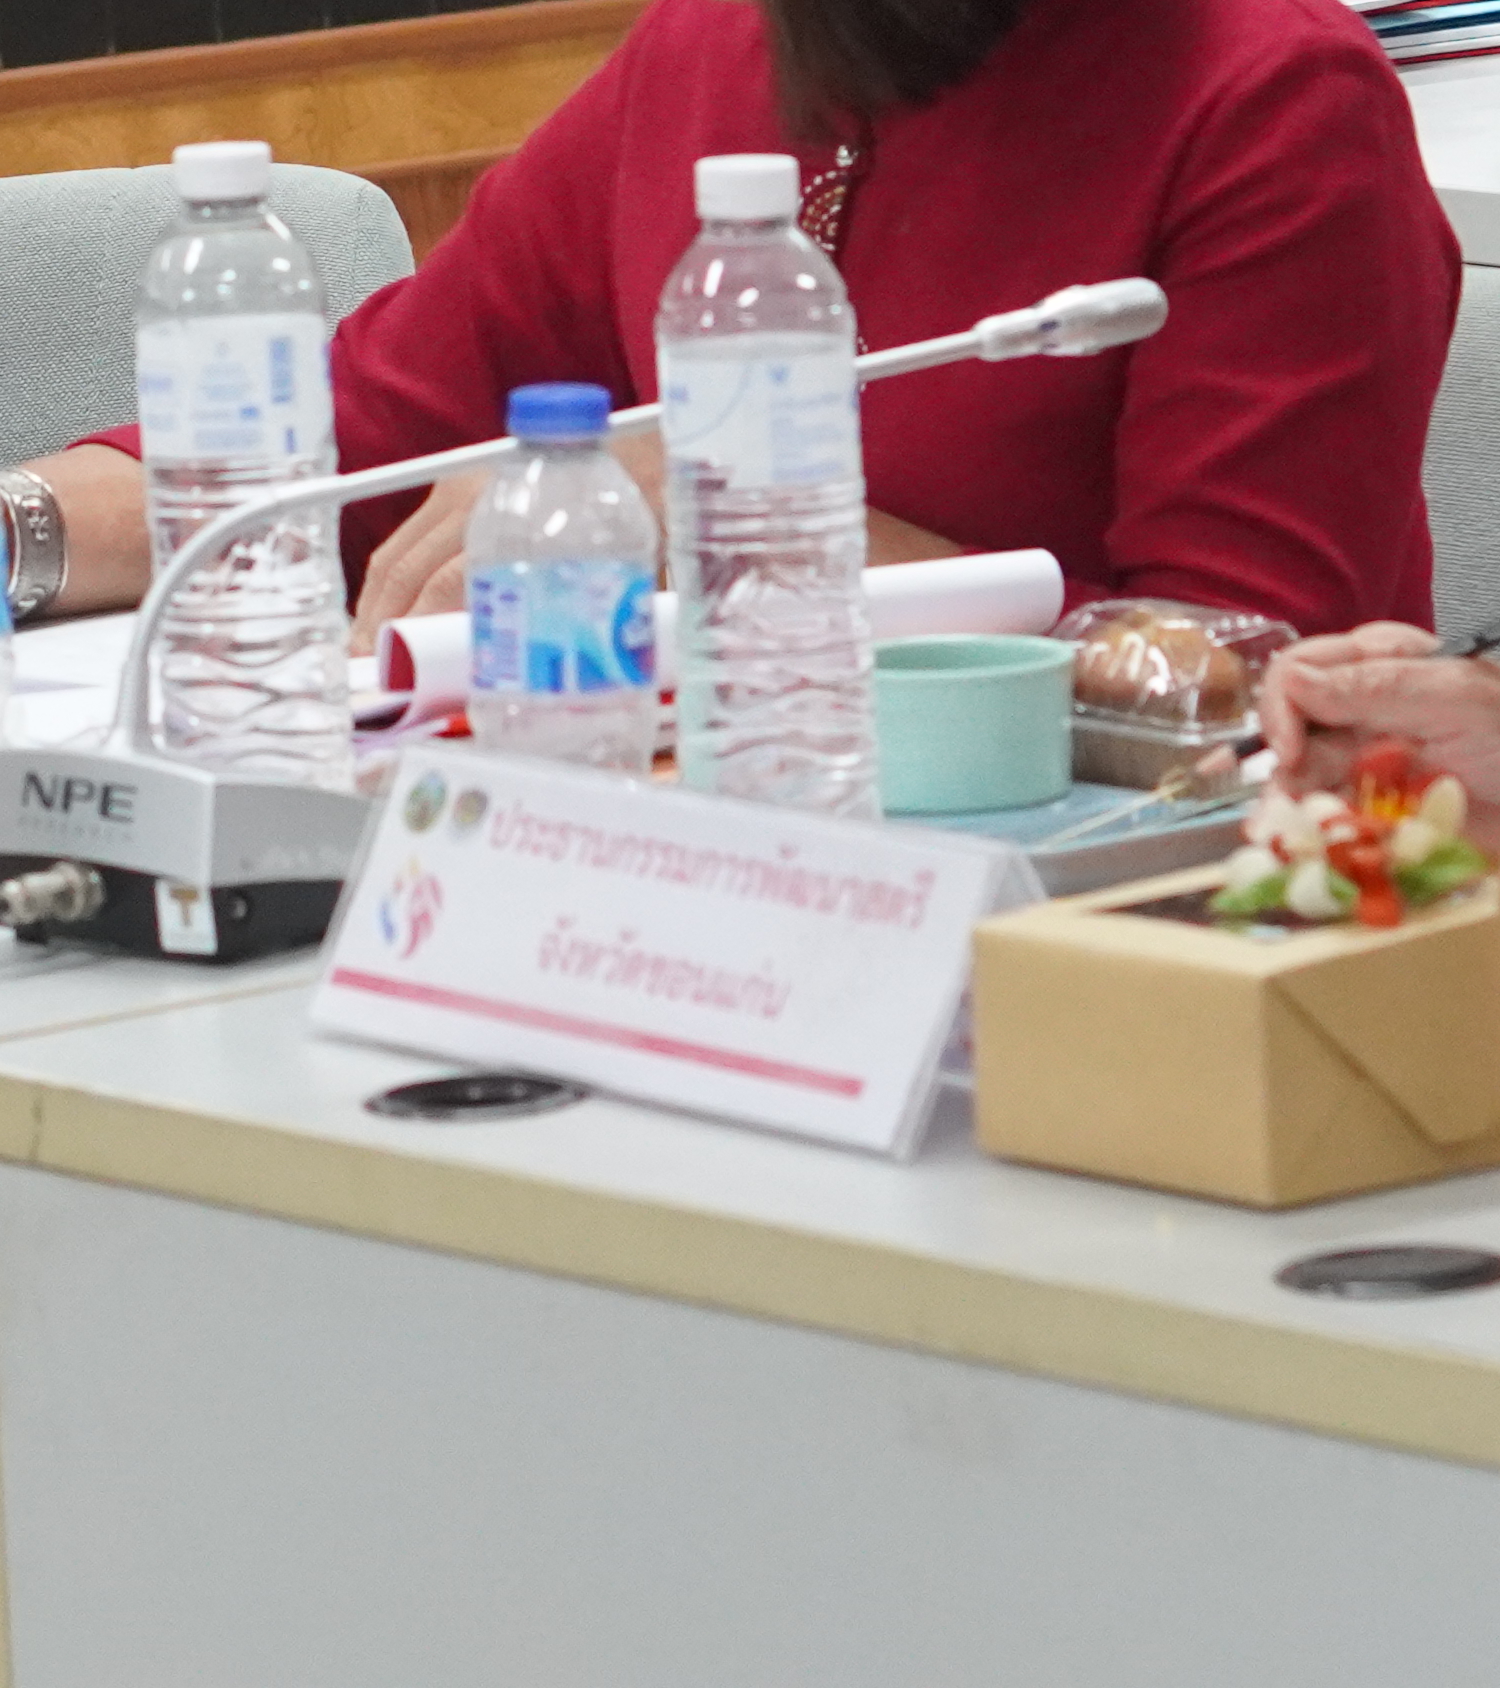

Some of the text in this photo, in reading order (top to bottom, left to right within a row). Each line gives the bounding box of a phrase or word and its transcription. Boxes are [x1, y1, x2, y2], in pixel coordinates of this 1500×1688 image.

[20, 770, 139, 824] NPE
[537, 913, 793, 1020] จังหวัดขอนแก่น
